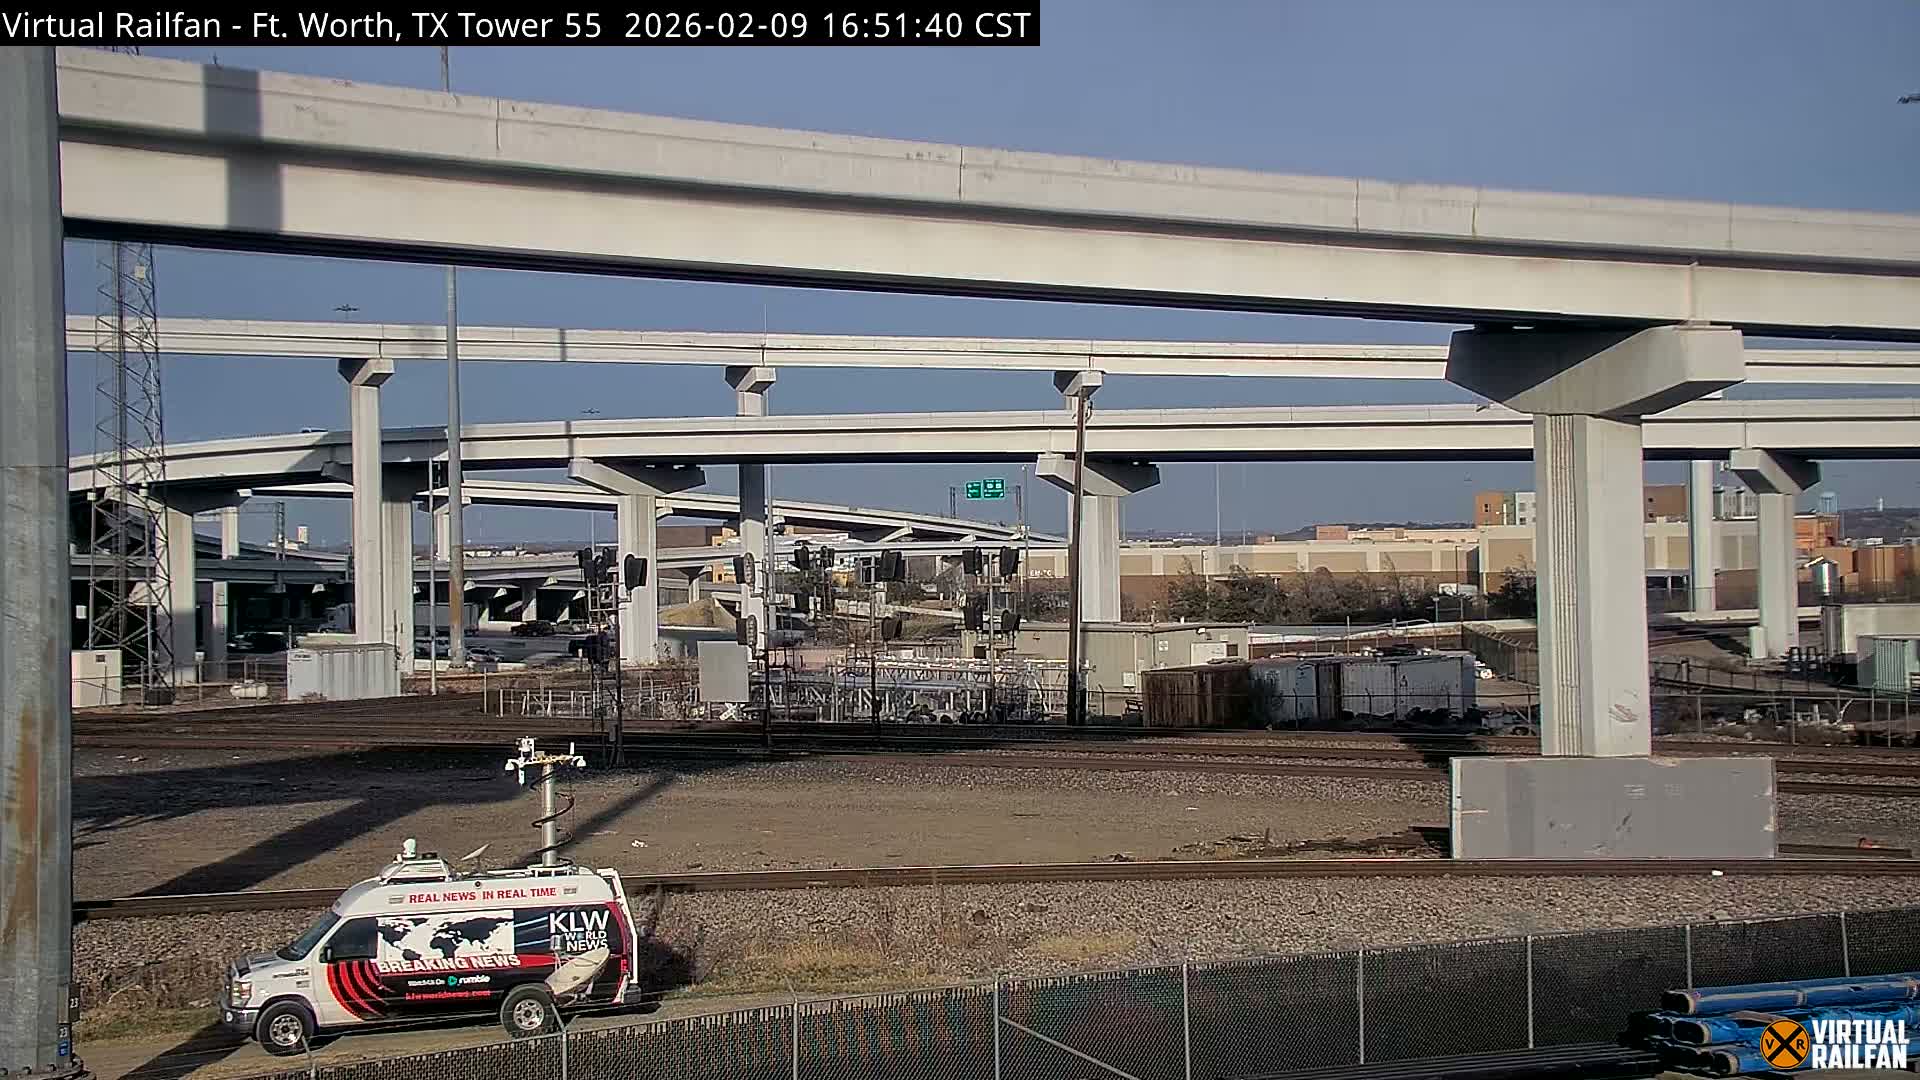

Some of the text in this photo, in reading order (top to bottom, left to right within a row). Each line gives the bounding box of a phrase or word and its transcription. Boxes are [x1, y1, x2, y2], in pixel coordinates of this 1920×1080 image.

[409, 887, 557, 904] REAL NEWS IN REAL TIME
[549, 909, 610, 934] KLW
[566, 939, 608, 952] NEWS
[378, 954, 521, 974] BREAKING NEWS
[457, 974, 491, 986] rumble
[70, 997, 79, 1009] 23
[59, 1026, 68, 1038] 23
